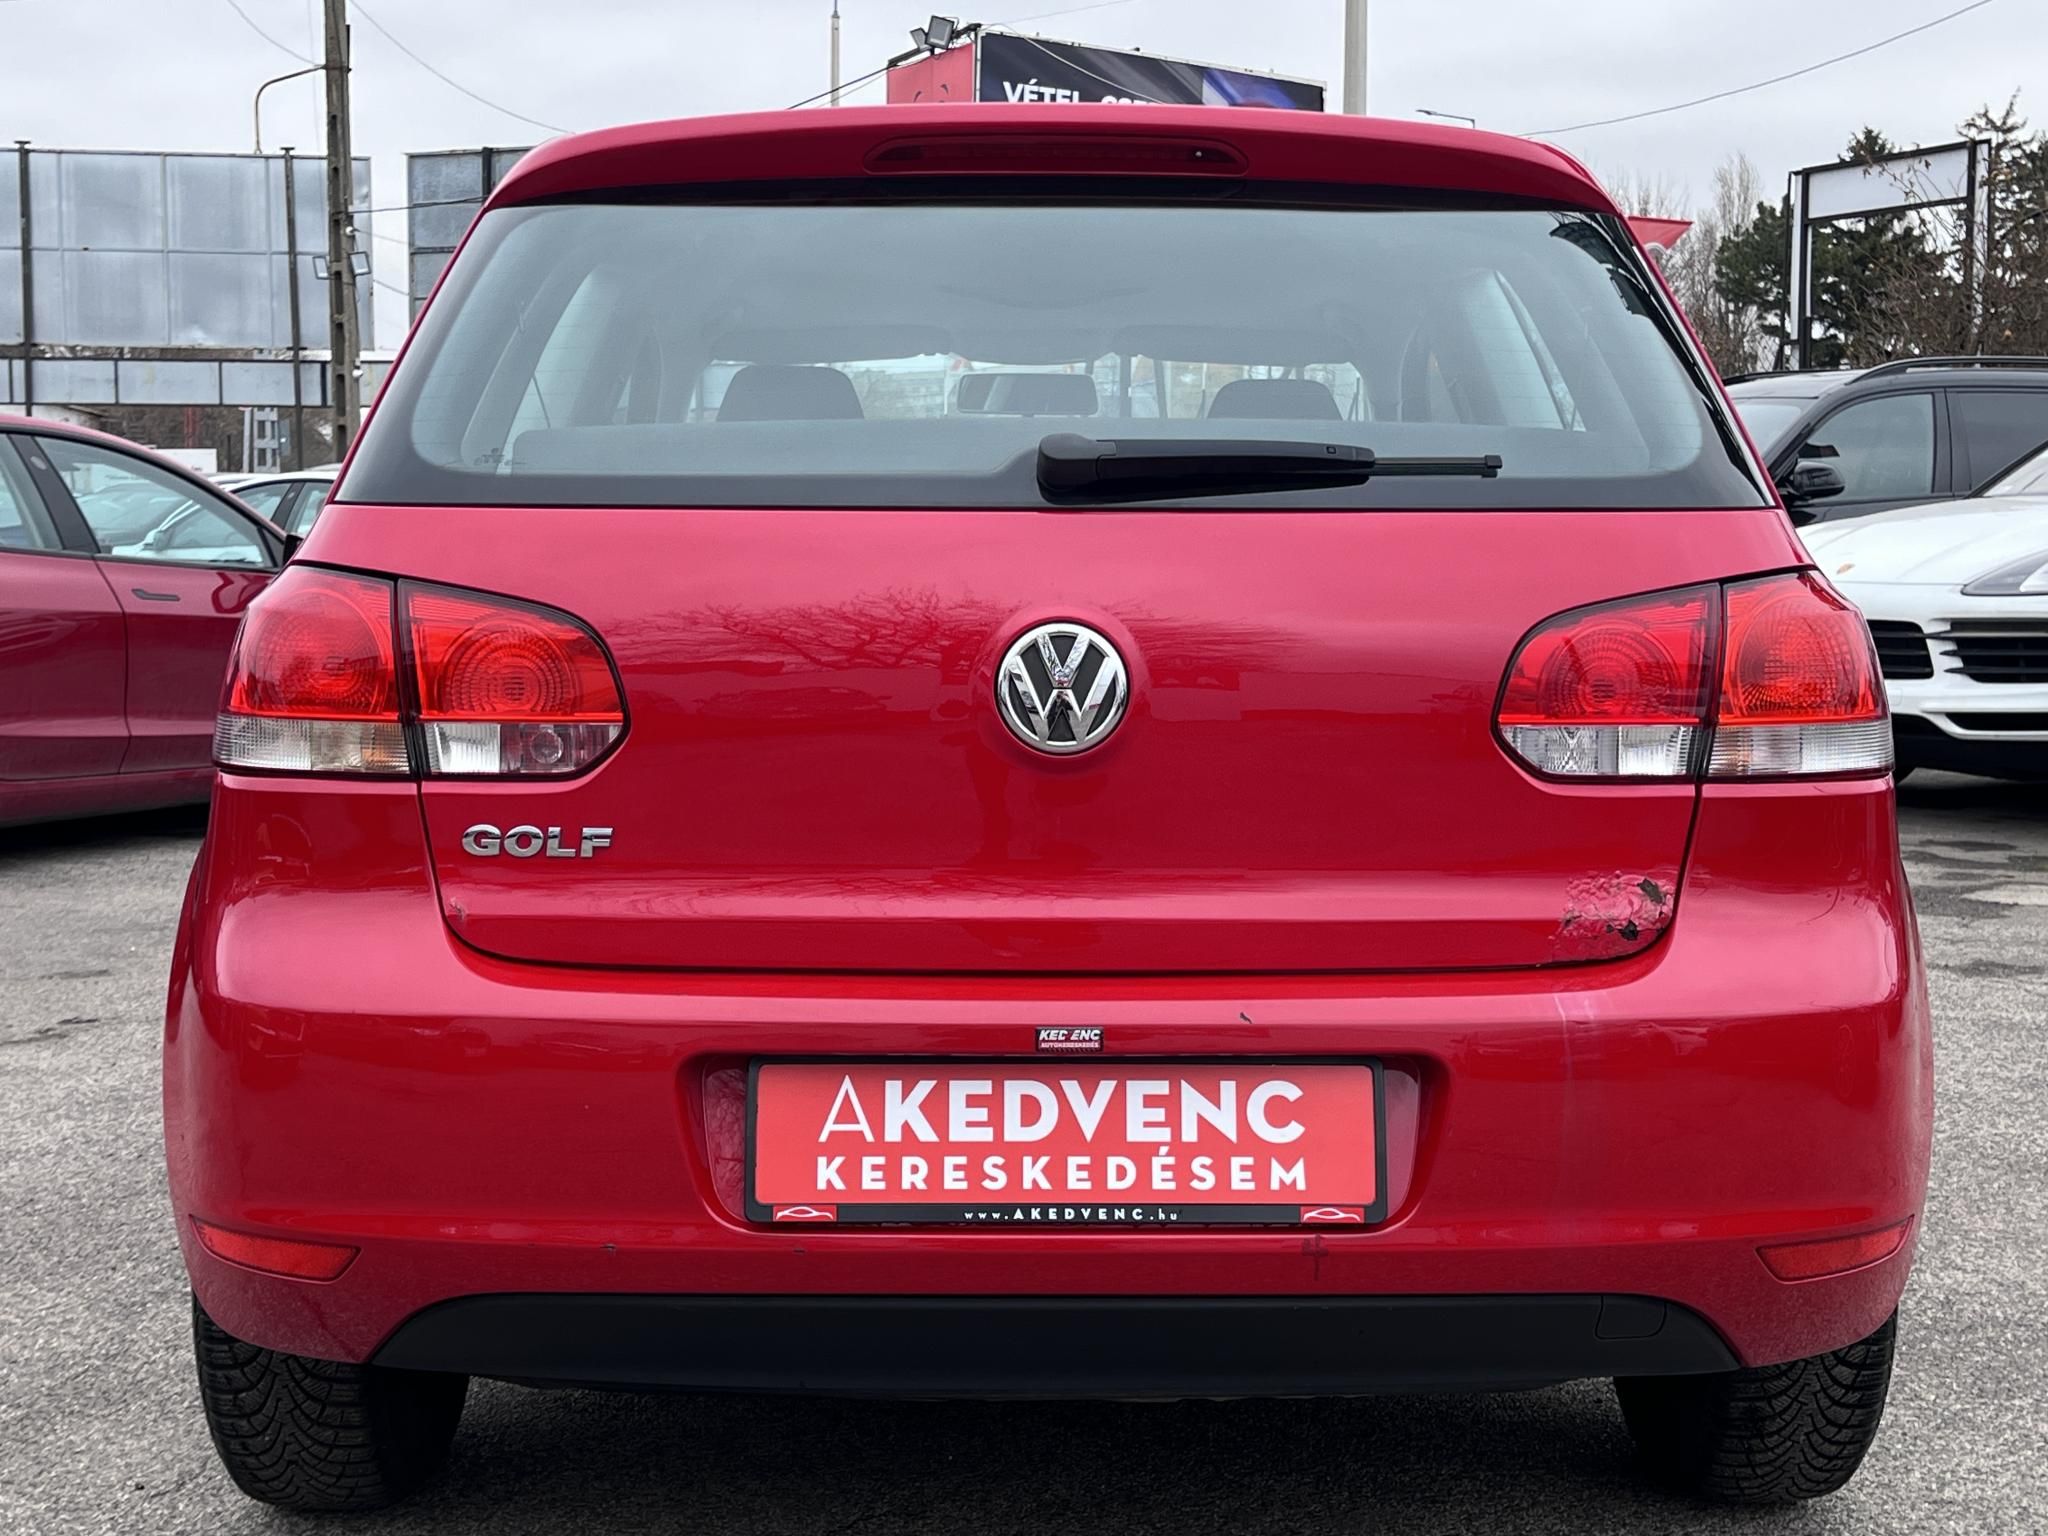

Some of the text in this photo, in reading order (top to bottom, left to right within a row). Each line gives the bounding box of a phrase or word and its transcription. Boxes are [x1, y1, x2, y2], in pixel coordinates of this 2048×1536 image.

[462, 824, 613, 857] GOLF
[1039, 1029, 1101, 1041] KEDENC
[816, 1146, 1307, 1192] KERESKEDÉSEM
[964, 1208, 1178, 1220] www.AKEDVENC.hu
